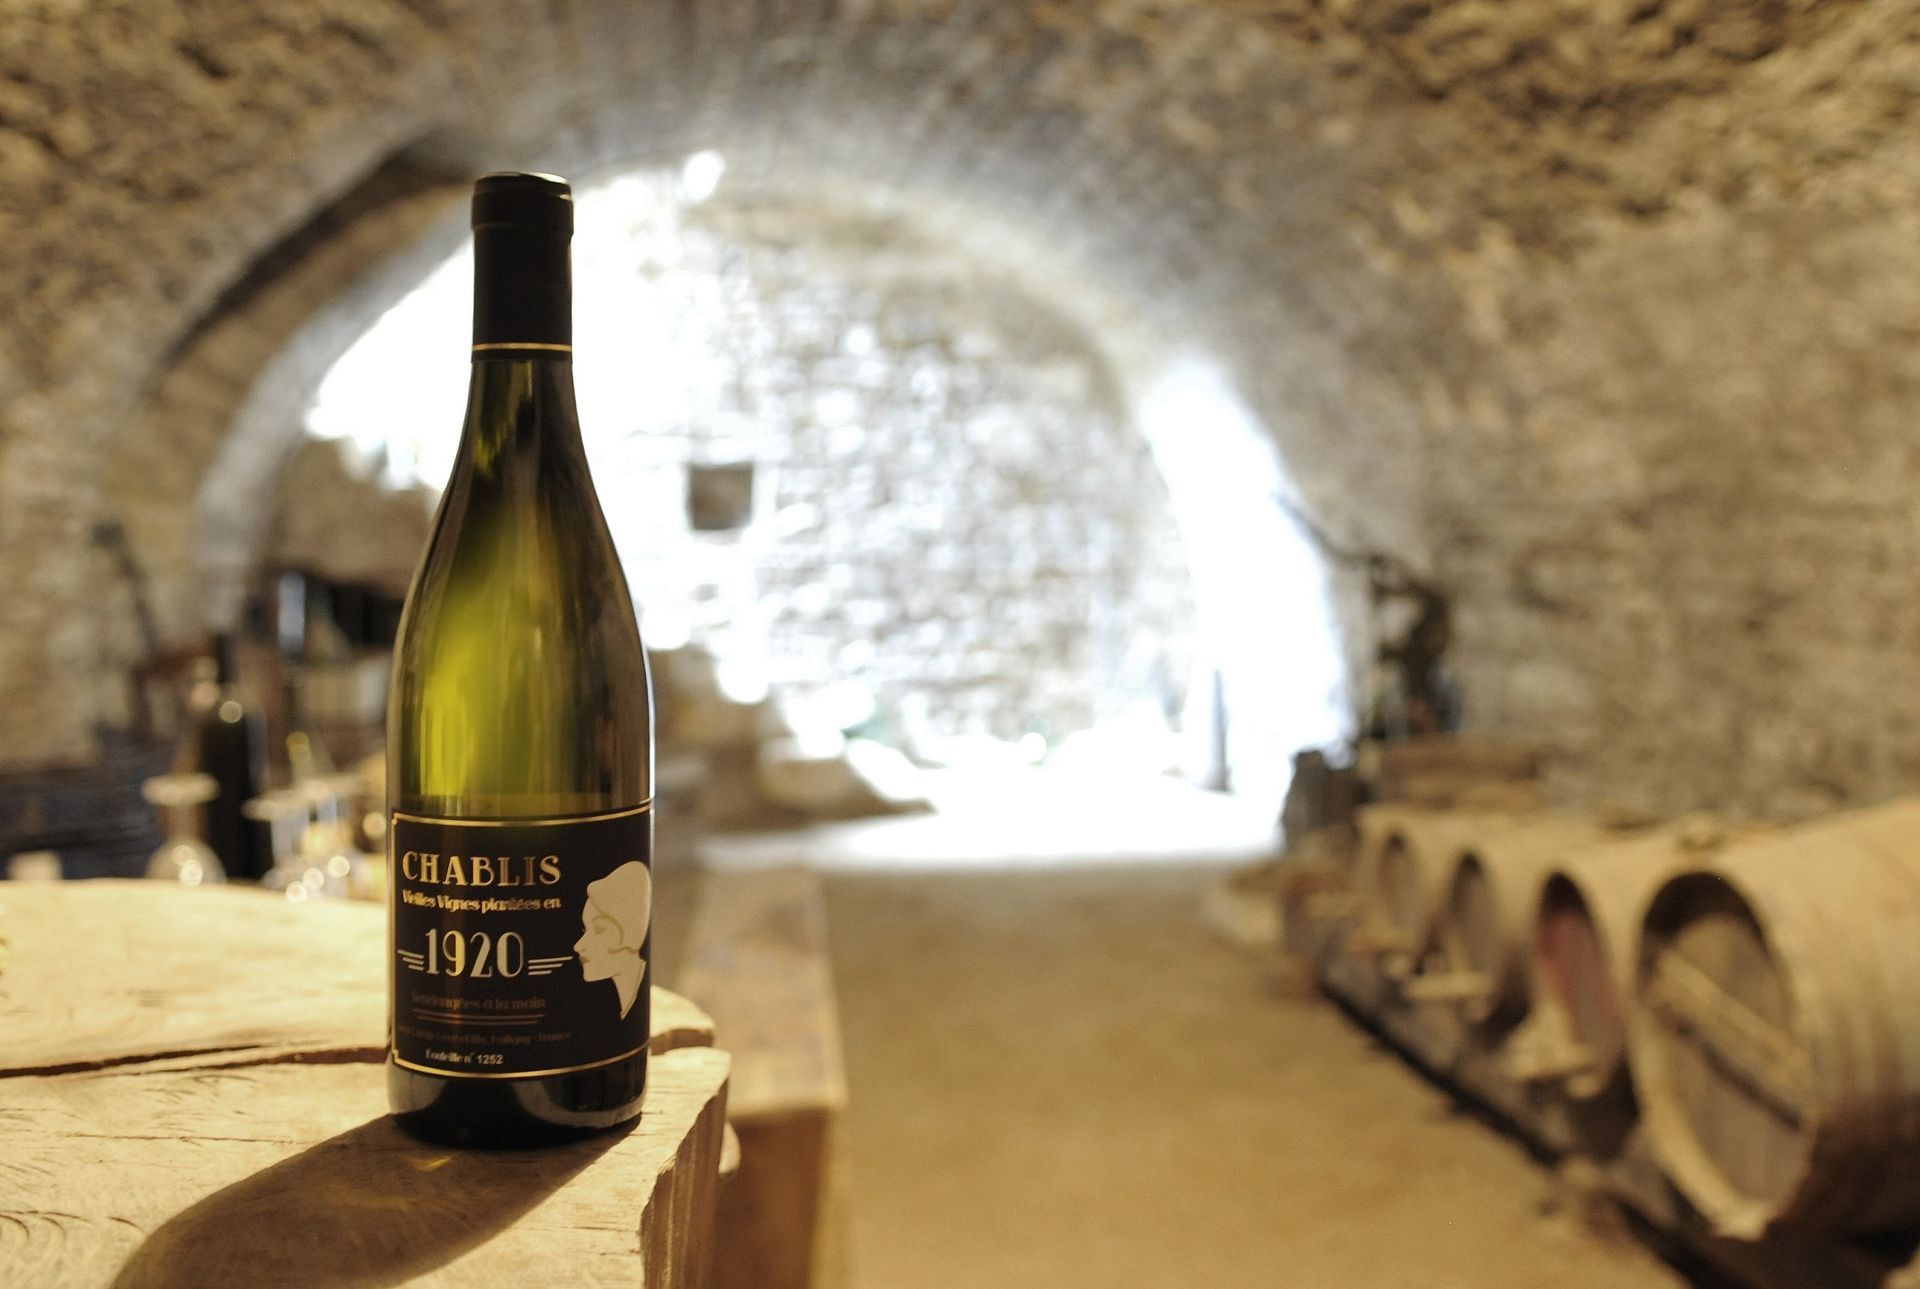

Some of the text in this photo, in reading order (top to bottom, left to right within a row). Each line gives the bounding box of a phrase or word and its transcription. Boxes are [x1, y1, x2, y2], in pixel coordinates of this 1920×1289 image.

[402, 851, 562, 886] CHABLIS
[437, 895, 481, 913] Vignes
[543, 897, 563, 909] en
[425, 928, 524, 978] 1920
